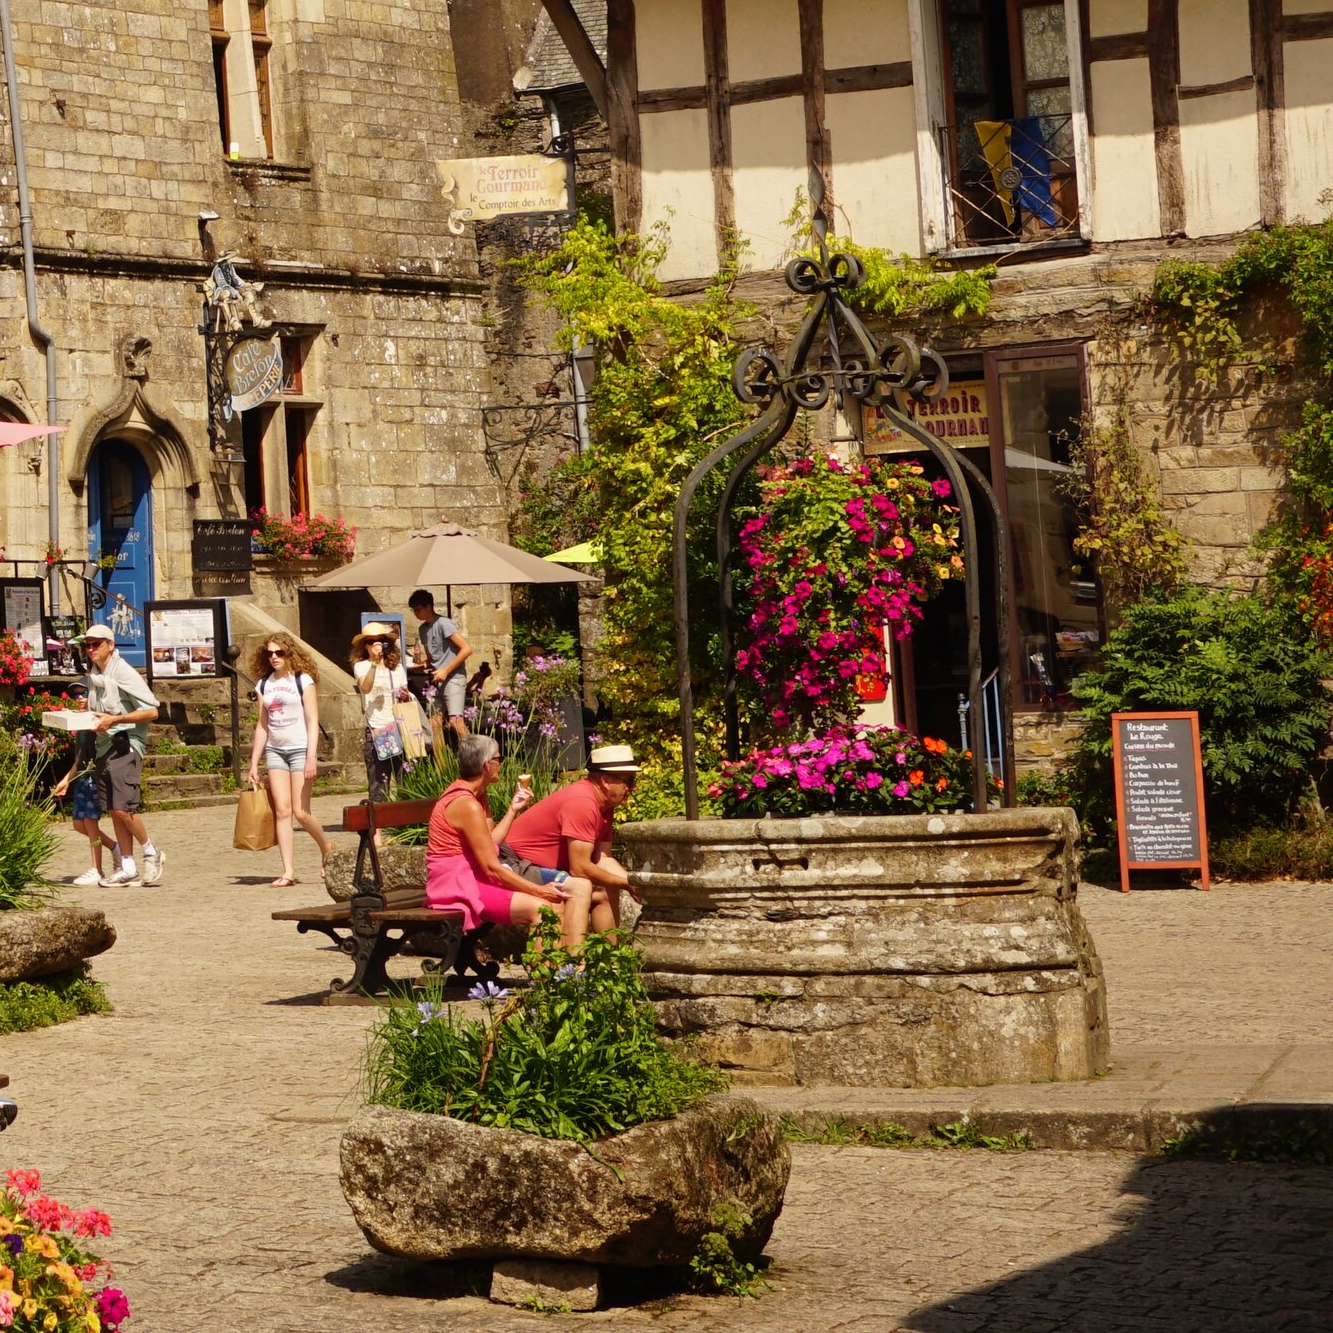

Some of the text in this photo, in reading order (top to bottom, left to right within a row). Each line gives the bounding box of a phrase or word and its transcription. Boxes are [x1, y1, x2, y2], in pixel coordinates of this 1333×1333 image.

[487, 165, 539, 181] Terroir
[477, 179, 547, 194] Gourmand
[470, 193, 556, 211] le Comptoir des Arts
[232, 338, 273, 394] Café Breton
[1126, 722, 1169, 732] Restaurant
[1130, 731, 1164, 741] Le Rouge
[1154, 741, 1175, 749] monde
[1127, 755, 1147, 763] Tapas
